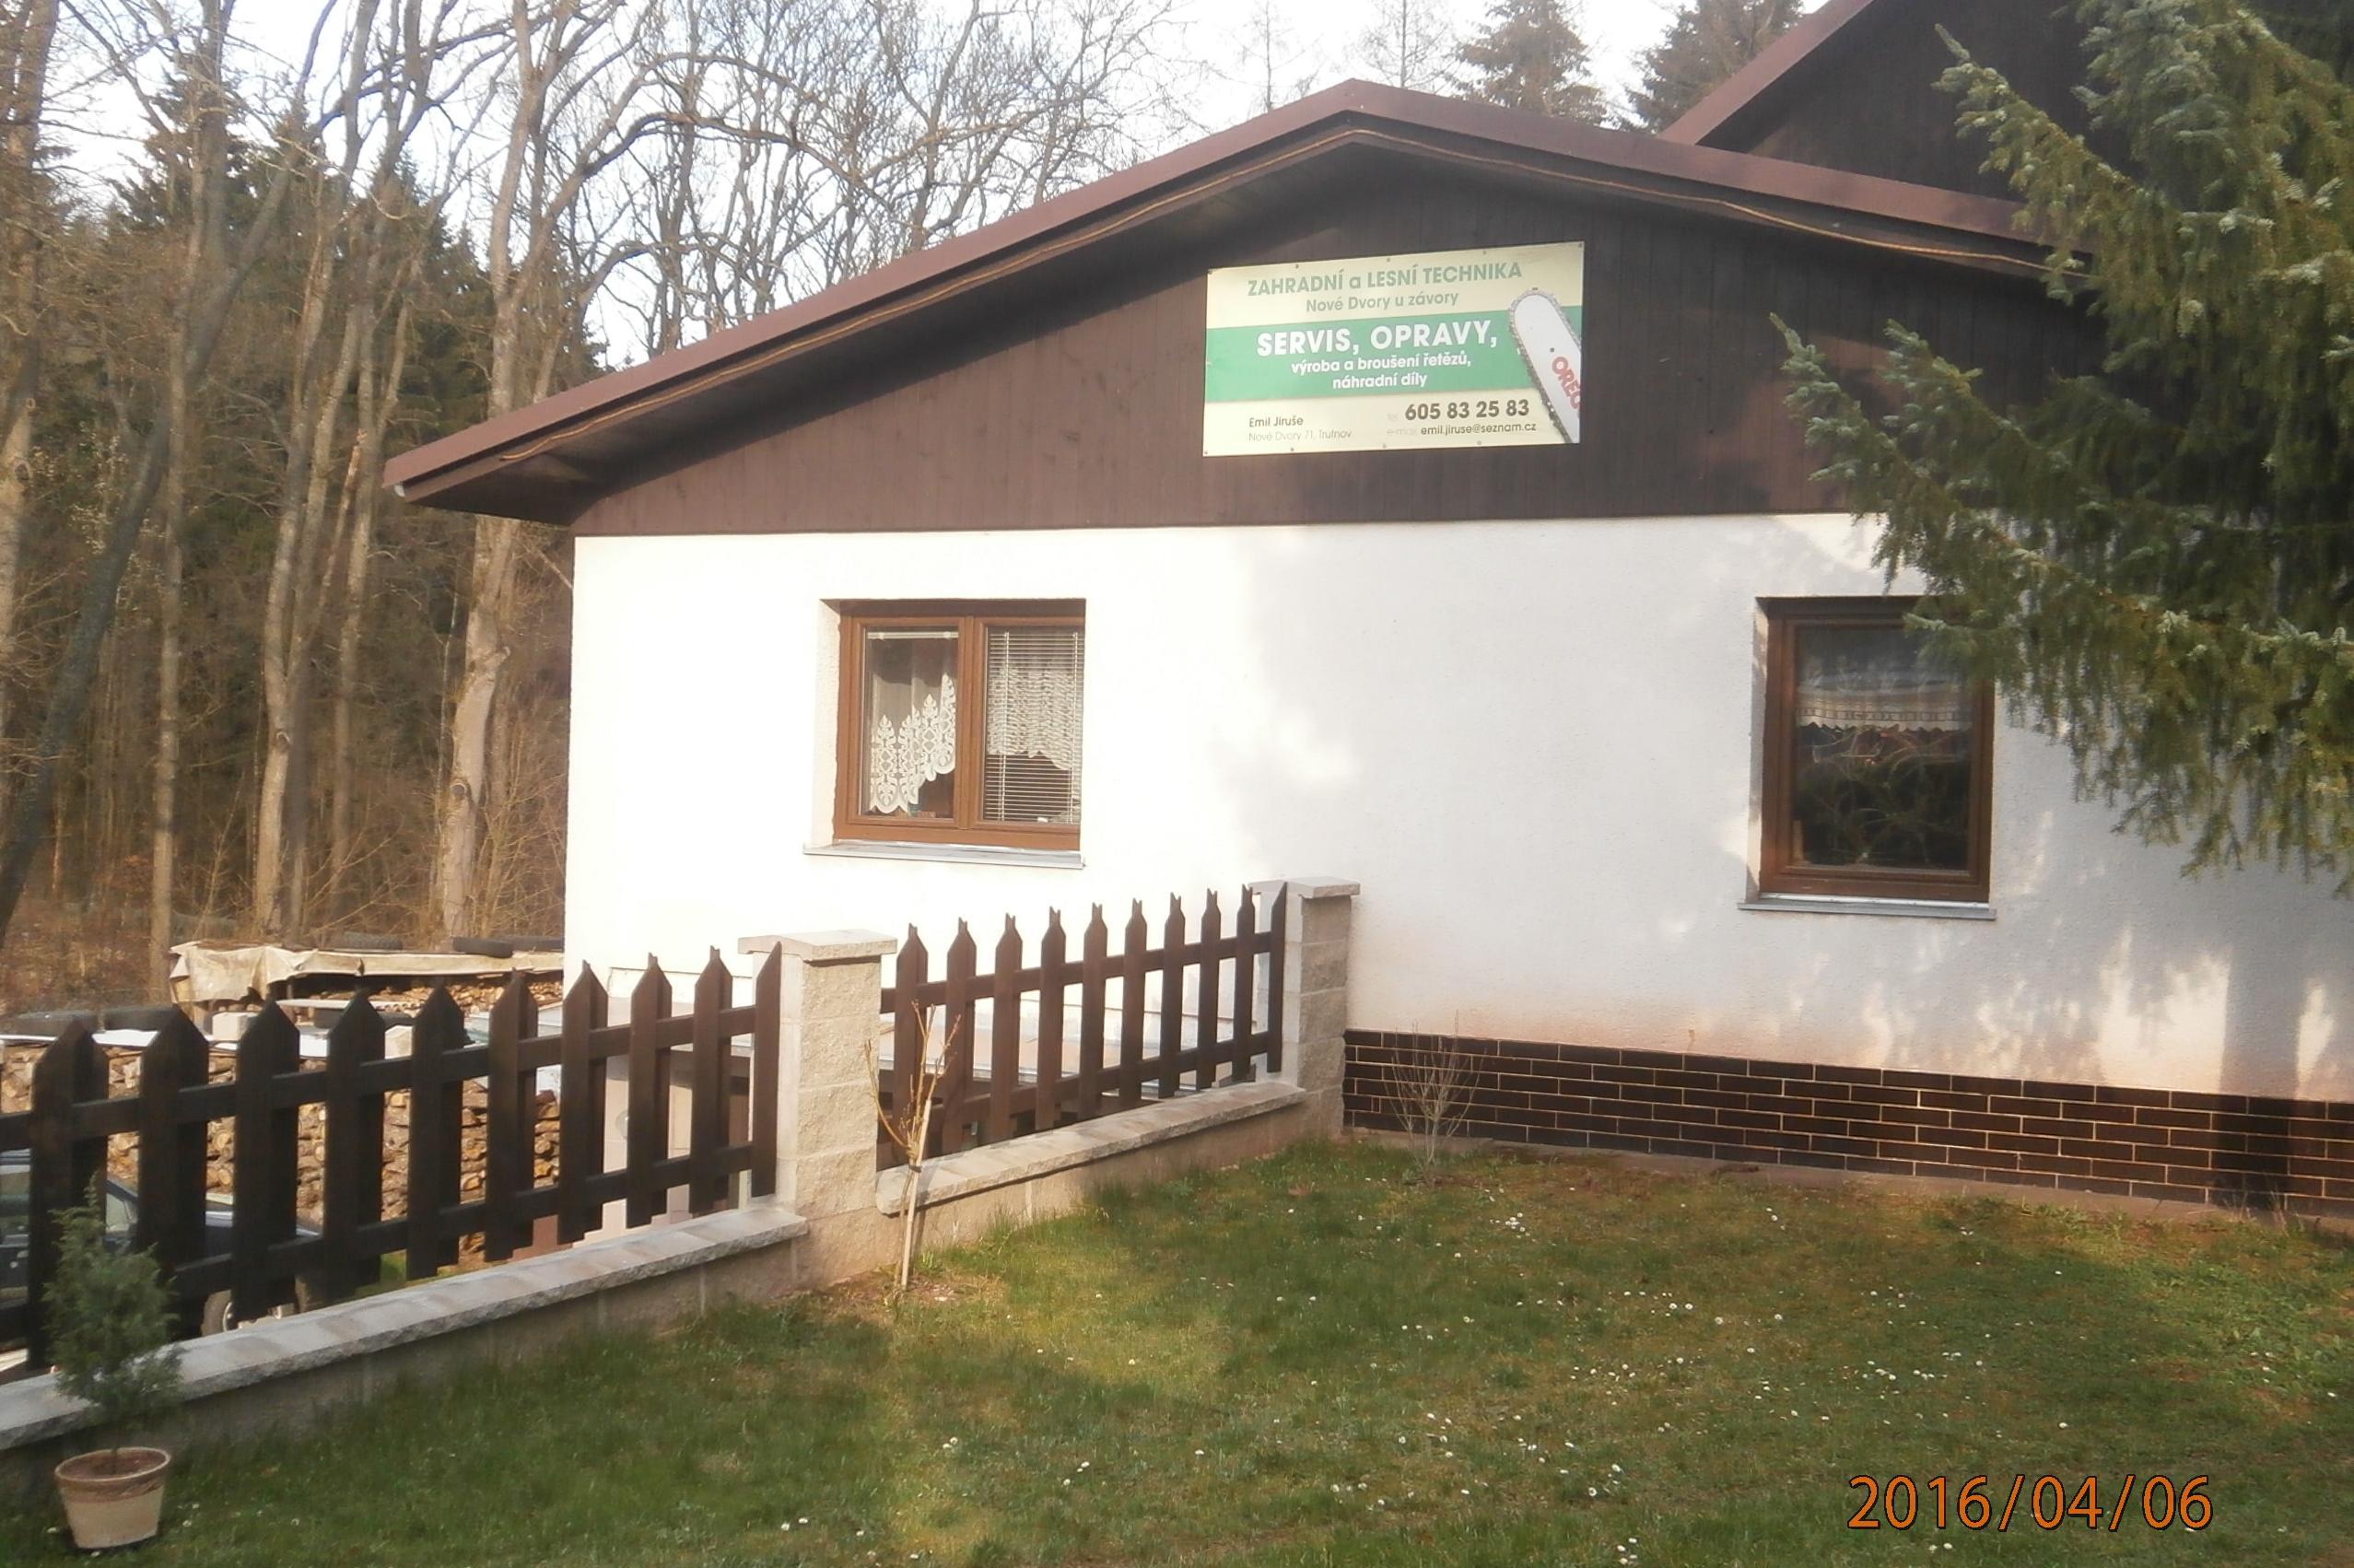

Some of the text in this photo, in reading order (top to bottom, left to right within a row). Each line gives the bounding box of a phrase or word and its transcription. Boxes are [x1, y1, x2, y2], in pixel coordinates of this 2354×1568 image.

[1247, 262, 1523, 297] ZAHRADNÍ a LESNÍ TECHNIKA
[1306, 291, 1459, 312] Nové Dvory u závory
[1256, 320, 1498, 357] SERVIS, OPRAVY,
[1291, 350, 1471, 376] výroba a broušení řetězů,
[1332, 372, 1428, 389] náhradní díly
[1405, 403, 1441, 421] 605
[1446, 401, 1470, 419] 83
[1476, 400, 1500, 418] 25
[1505, 398, 1529, 416] 83
[1248, 415, 1305, 428] Emil Jiruše
[1421, 421, 1538, 436] emil.jiruse@seznam.cz
[1248, 431, 1273, 442] Nové
[1275, 430, 1301, 441] Dvory
